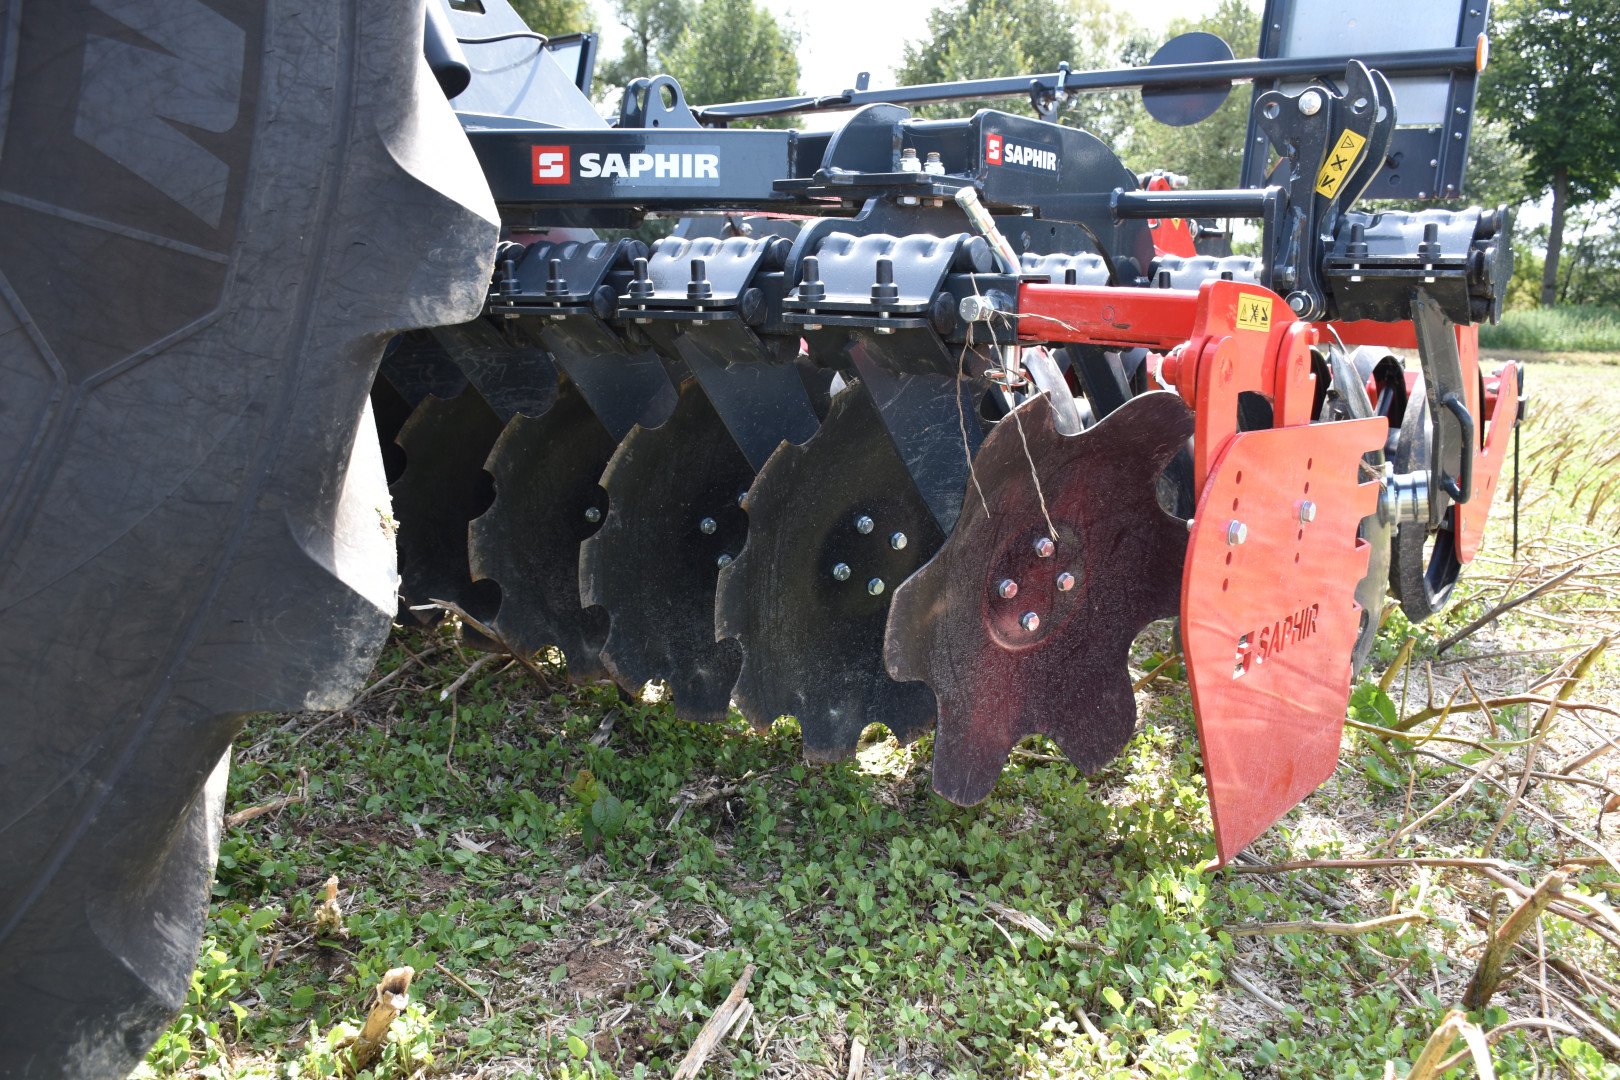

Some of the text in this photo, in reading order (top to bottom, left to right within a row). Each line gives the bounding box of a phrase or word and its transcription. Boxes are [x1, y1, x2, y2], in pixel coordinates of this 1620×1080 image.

[579, 152, 719, 179] SAPHIR
[1004, 143, 1057, 171] SAPHIR
[1255, 603, 1319, 665] SAPHIR
